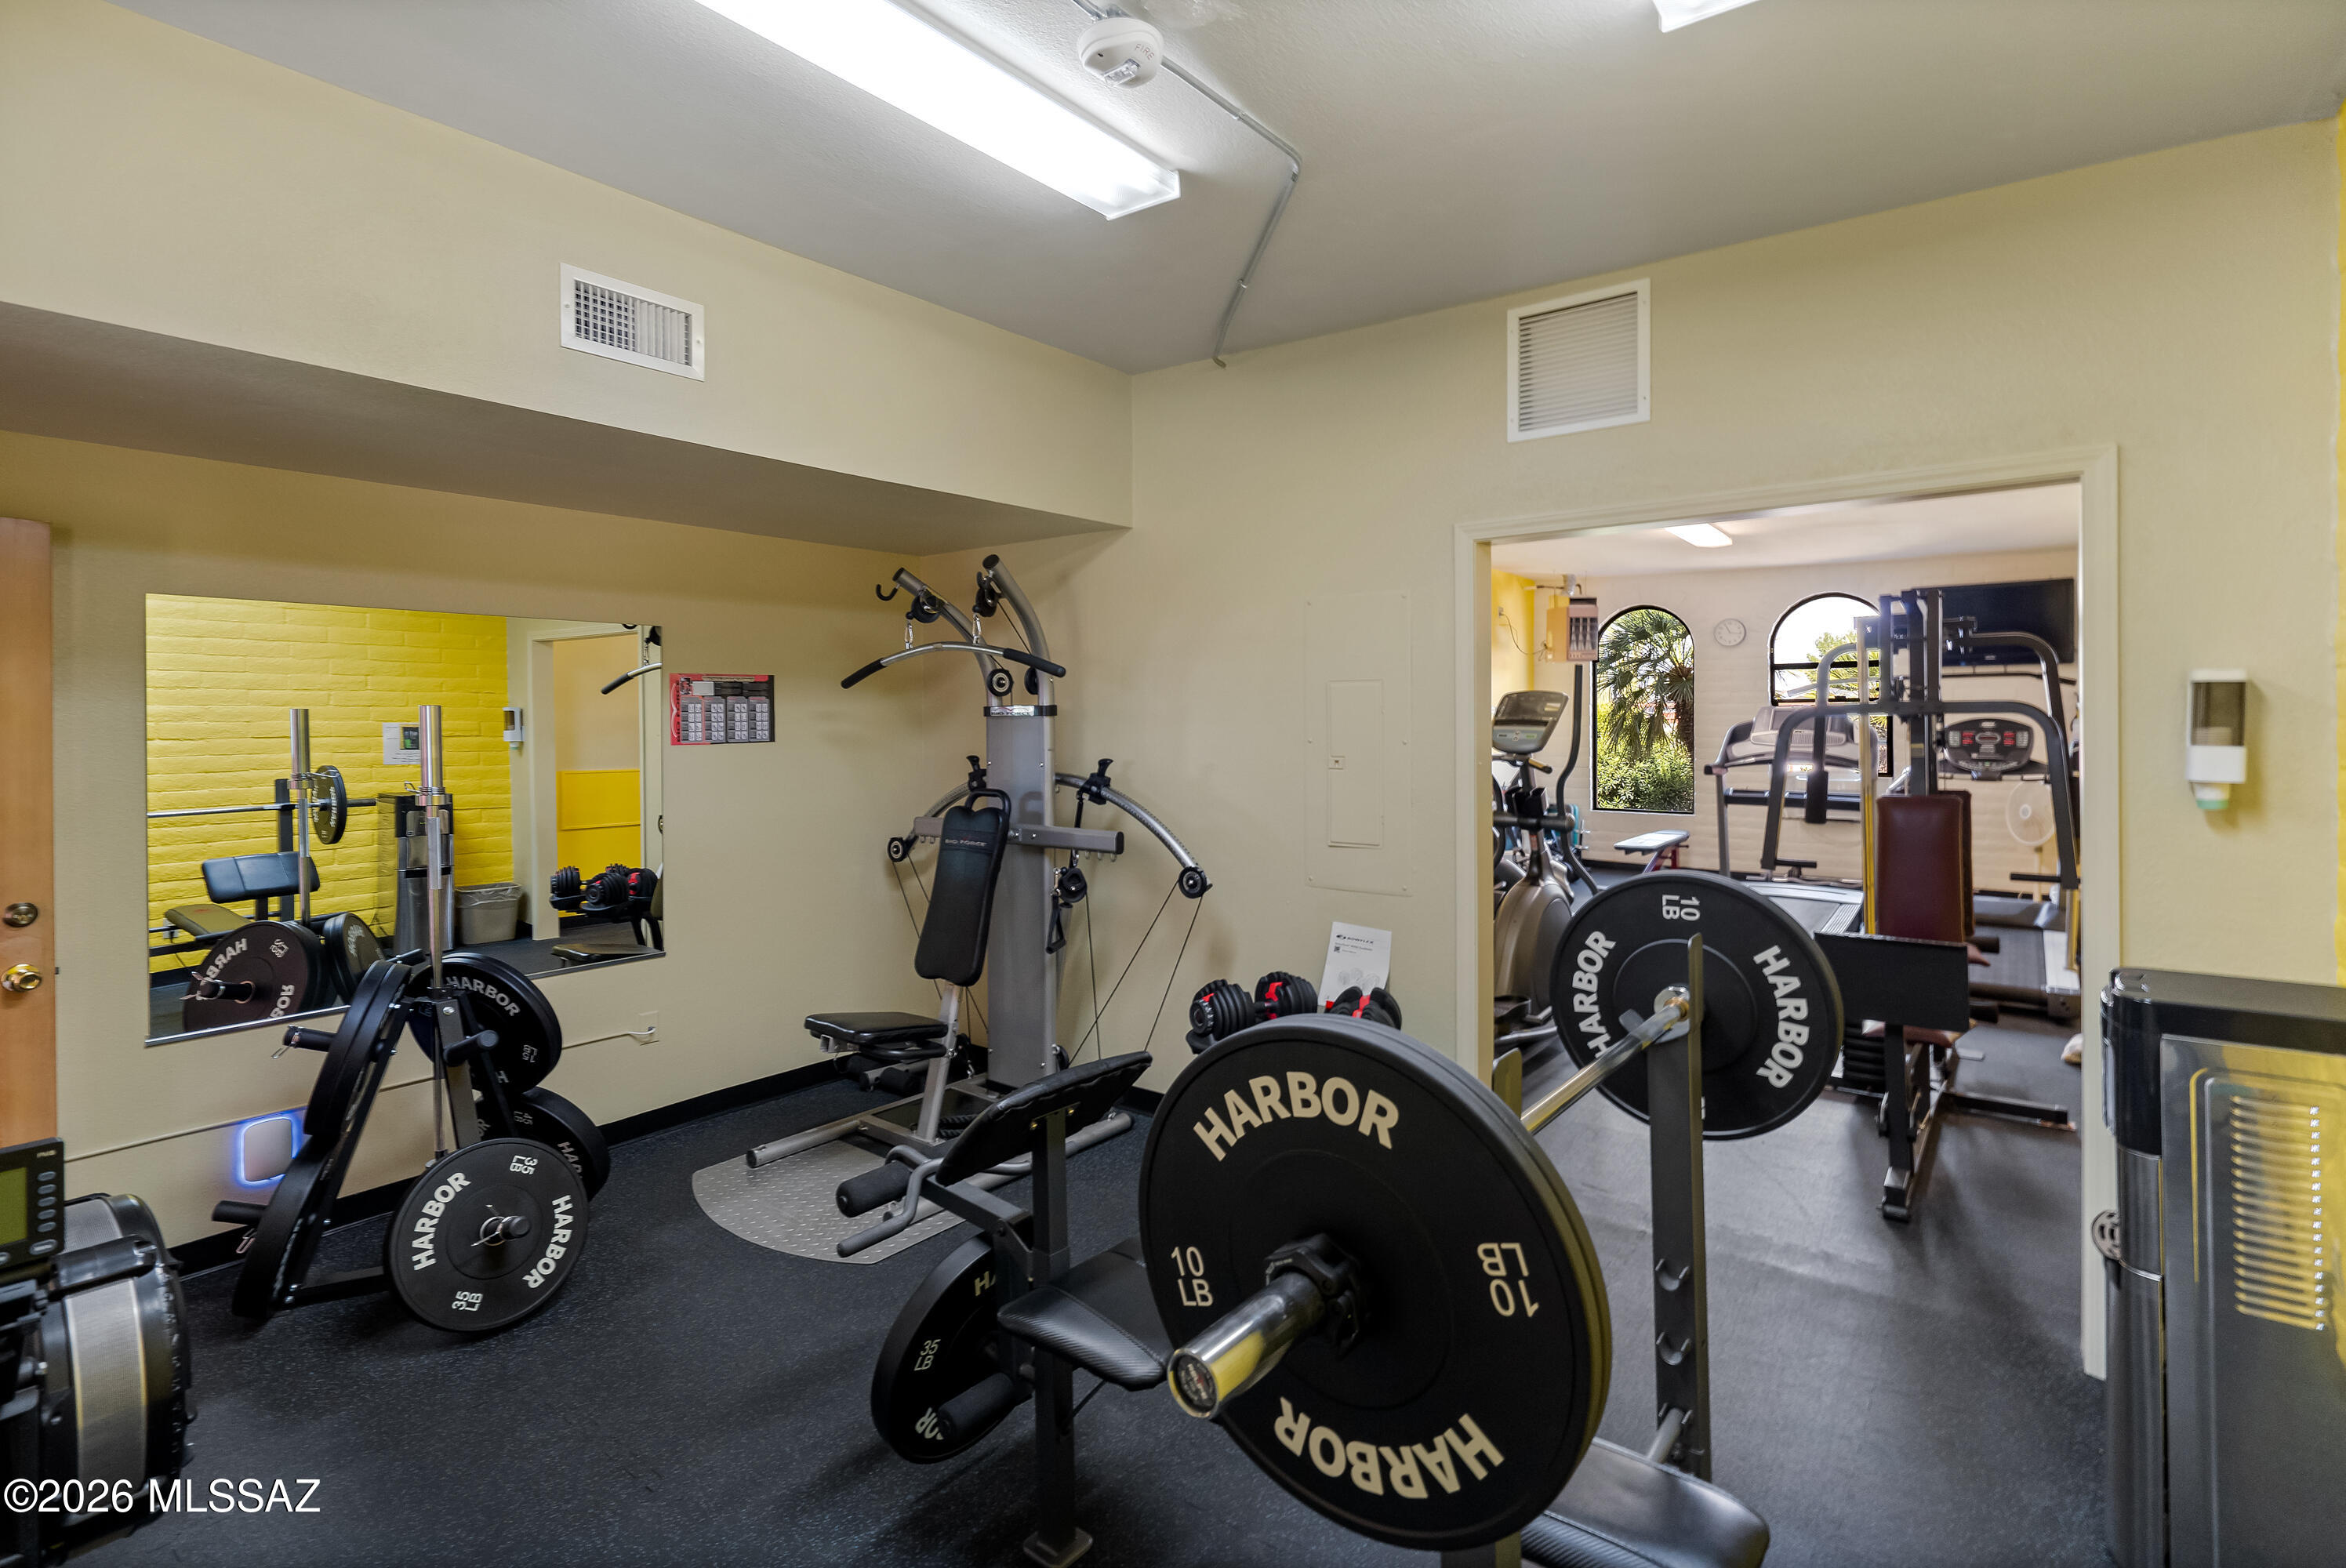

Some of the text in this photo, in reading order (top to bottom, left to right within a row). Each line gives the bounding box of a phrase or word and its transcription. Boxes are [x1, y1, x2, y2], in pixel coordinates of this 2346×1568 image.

[1135, 44, 1155, 60] FIRE
[1661, 894, 1680, 920] LB
[1680, 895, 1700, 921] 10
[445, 976, 521, 1017] HARBOR
[1572, 931, 1616, 1058] HARBOR
[1753, 944, 1810, 1088] HARBOR
[1193, 1070, 1400, 1162] HARBOR
[509, 1155, 526, 1172] LB
[521, 1156, 539, 1174] 35
[412, 1172, 470, 1271] HARBOR
[521, 1195, 574, 1288] HARBOR
[1171, 1246, 1205, 1276] 10
[1476, 1242, 1530, 1277] LB
[452, 1290, 470, 1311] 35
[465, 1293, 483, 1312] LB
[1180, 1278, 1214, 1307] LB
[1490, 1279, 1539, 1318] 10
[920, 1338, 942, 1356] 35
[913, 1355, 935, 1371] LB
[1273, 1396, 1505, 1499] HARBOR
